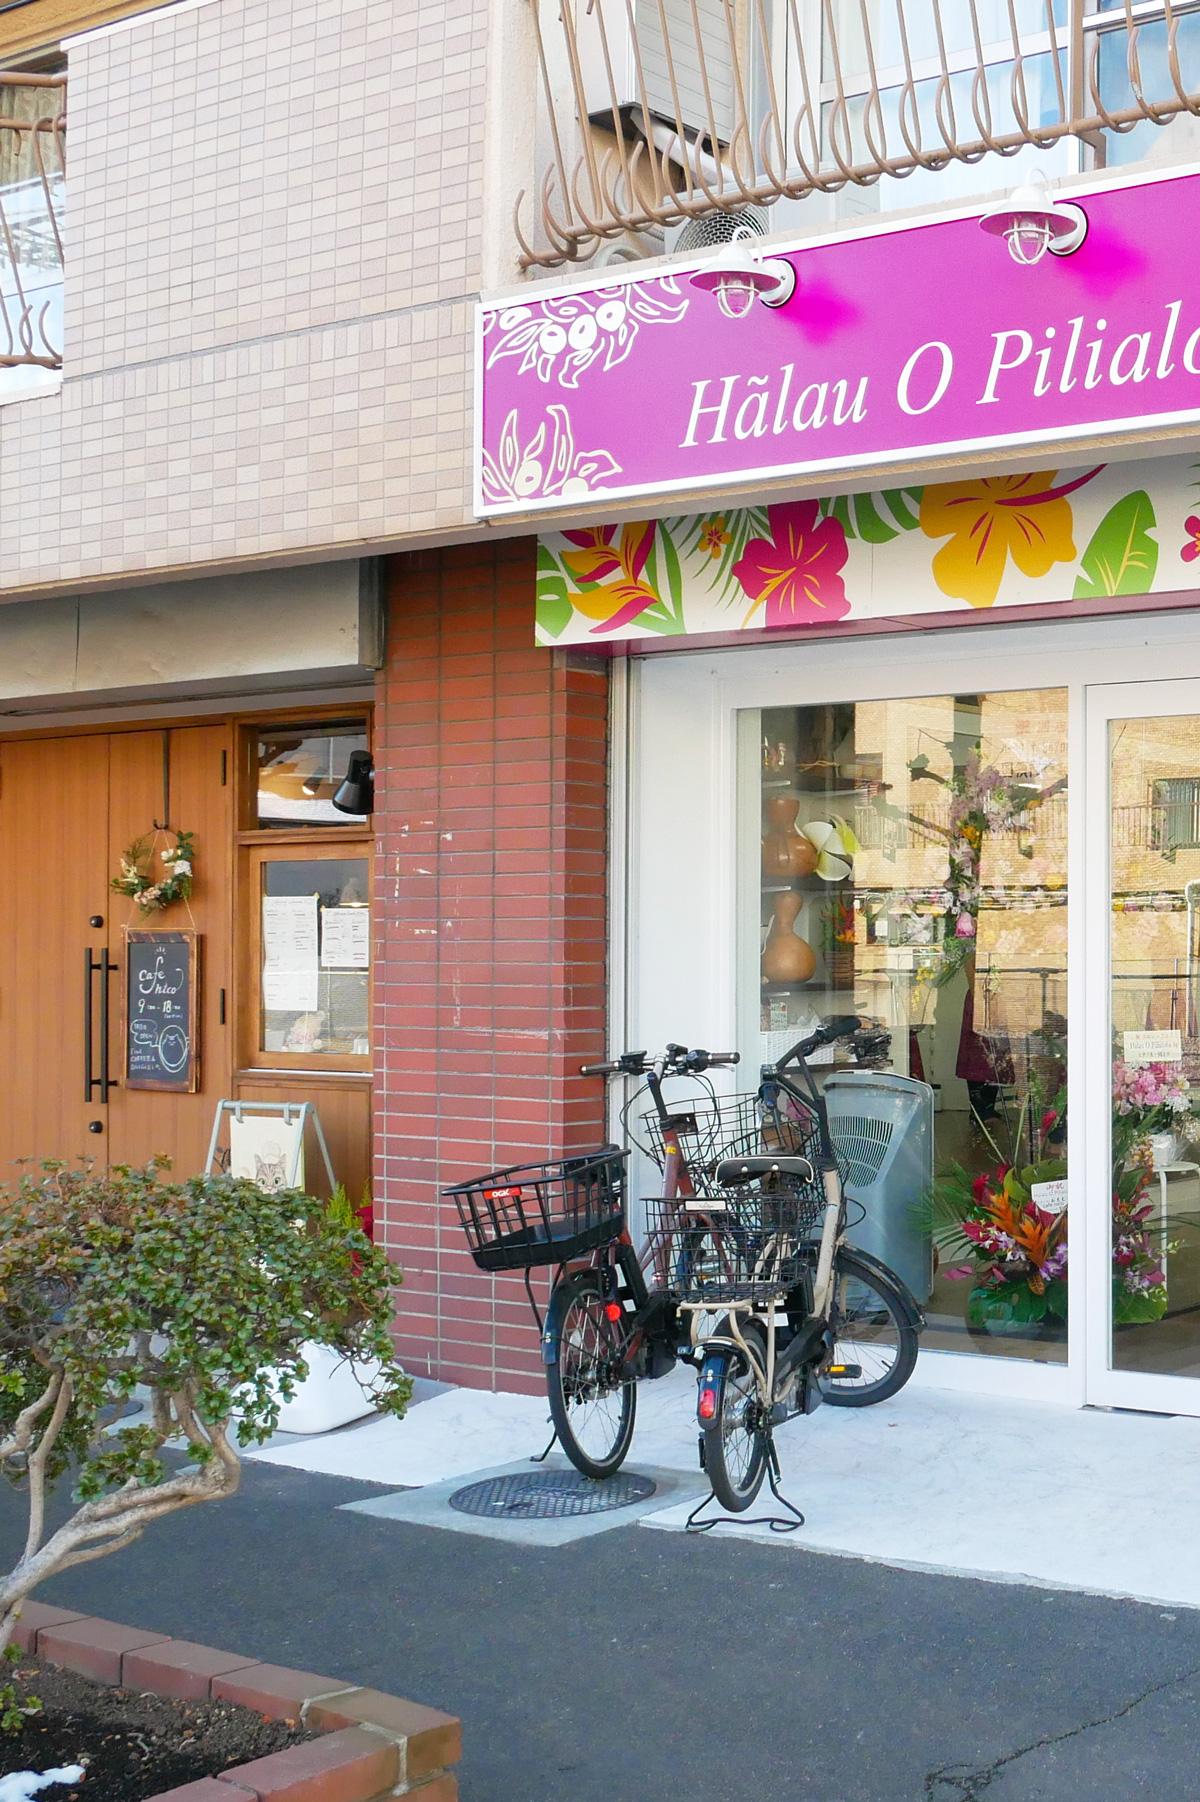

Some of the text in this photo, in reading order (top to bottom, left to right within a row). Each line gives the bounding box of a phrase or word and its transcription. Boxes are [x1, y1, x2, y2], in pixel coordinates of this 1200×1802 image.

[678, 363, 869, 449] Hãlau
[896, 341, 954, 416] O
[138, 955, 166, 994] Cafe
